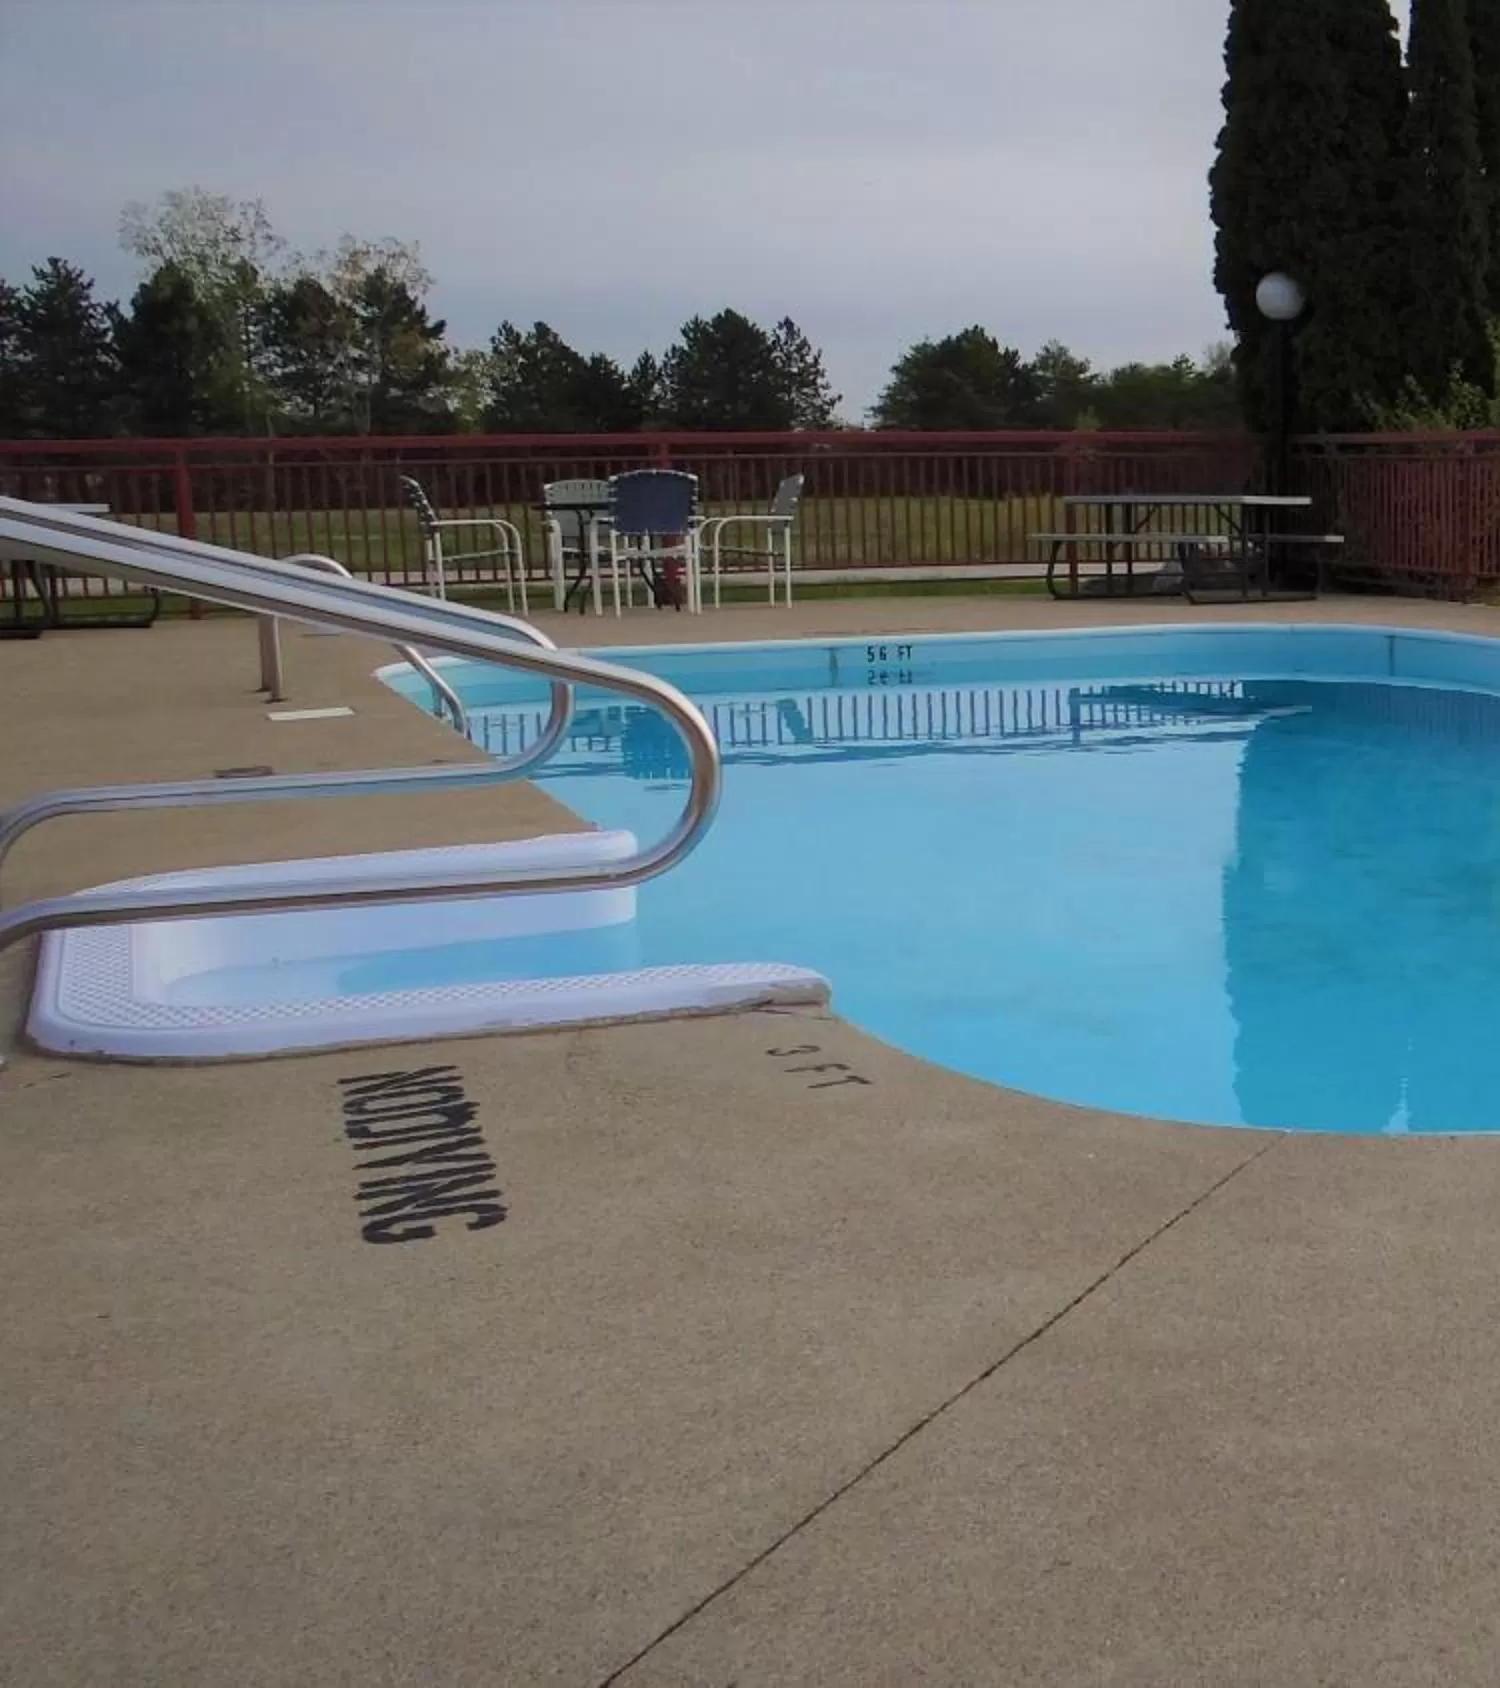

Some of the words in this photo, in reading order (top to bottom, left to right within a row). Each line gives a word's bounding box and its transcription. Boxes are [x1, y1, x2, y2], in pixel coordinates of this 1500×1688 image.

[898, 645, 913, 661] FT
[765, 1045, 821, 1057] 3
[783, 1063, 873, 1089] FT
